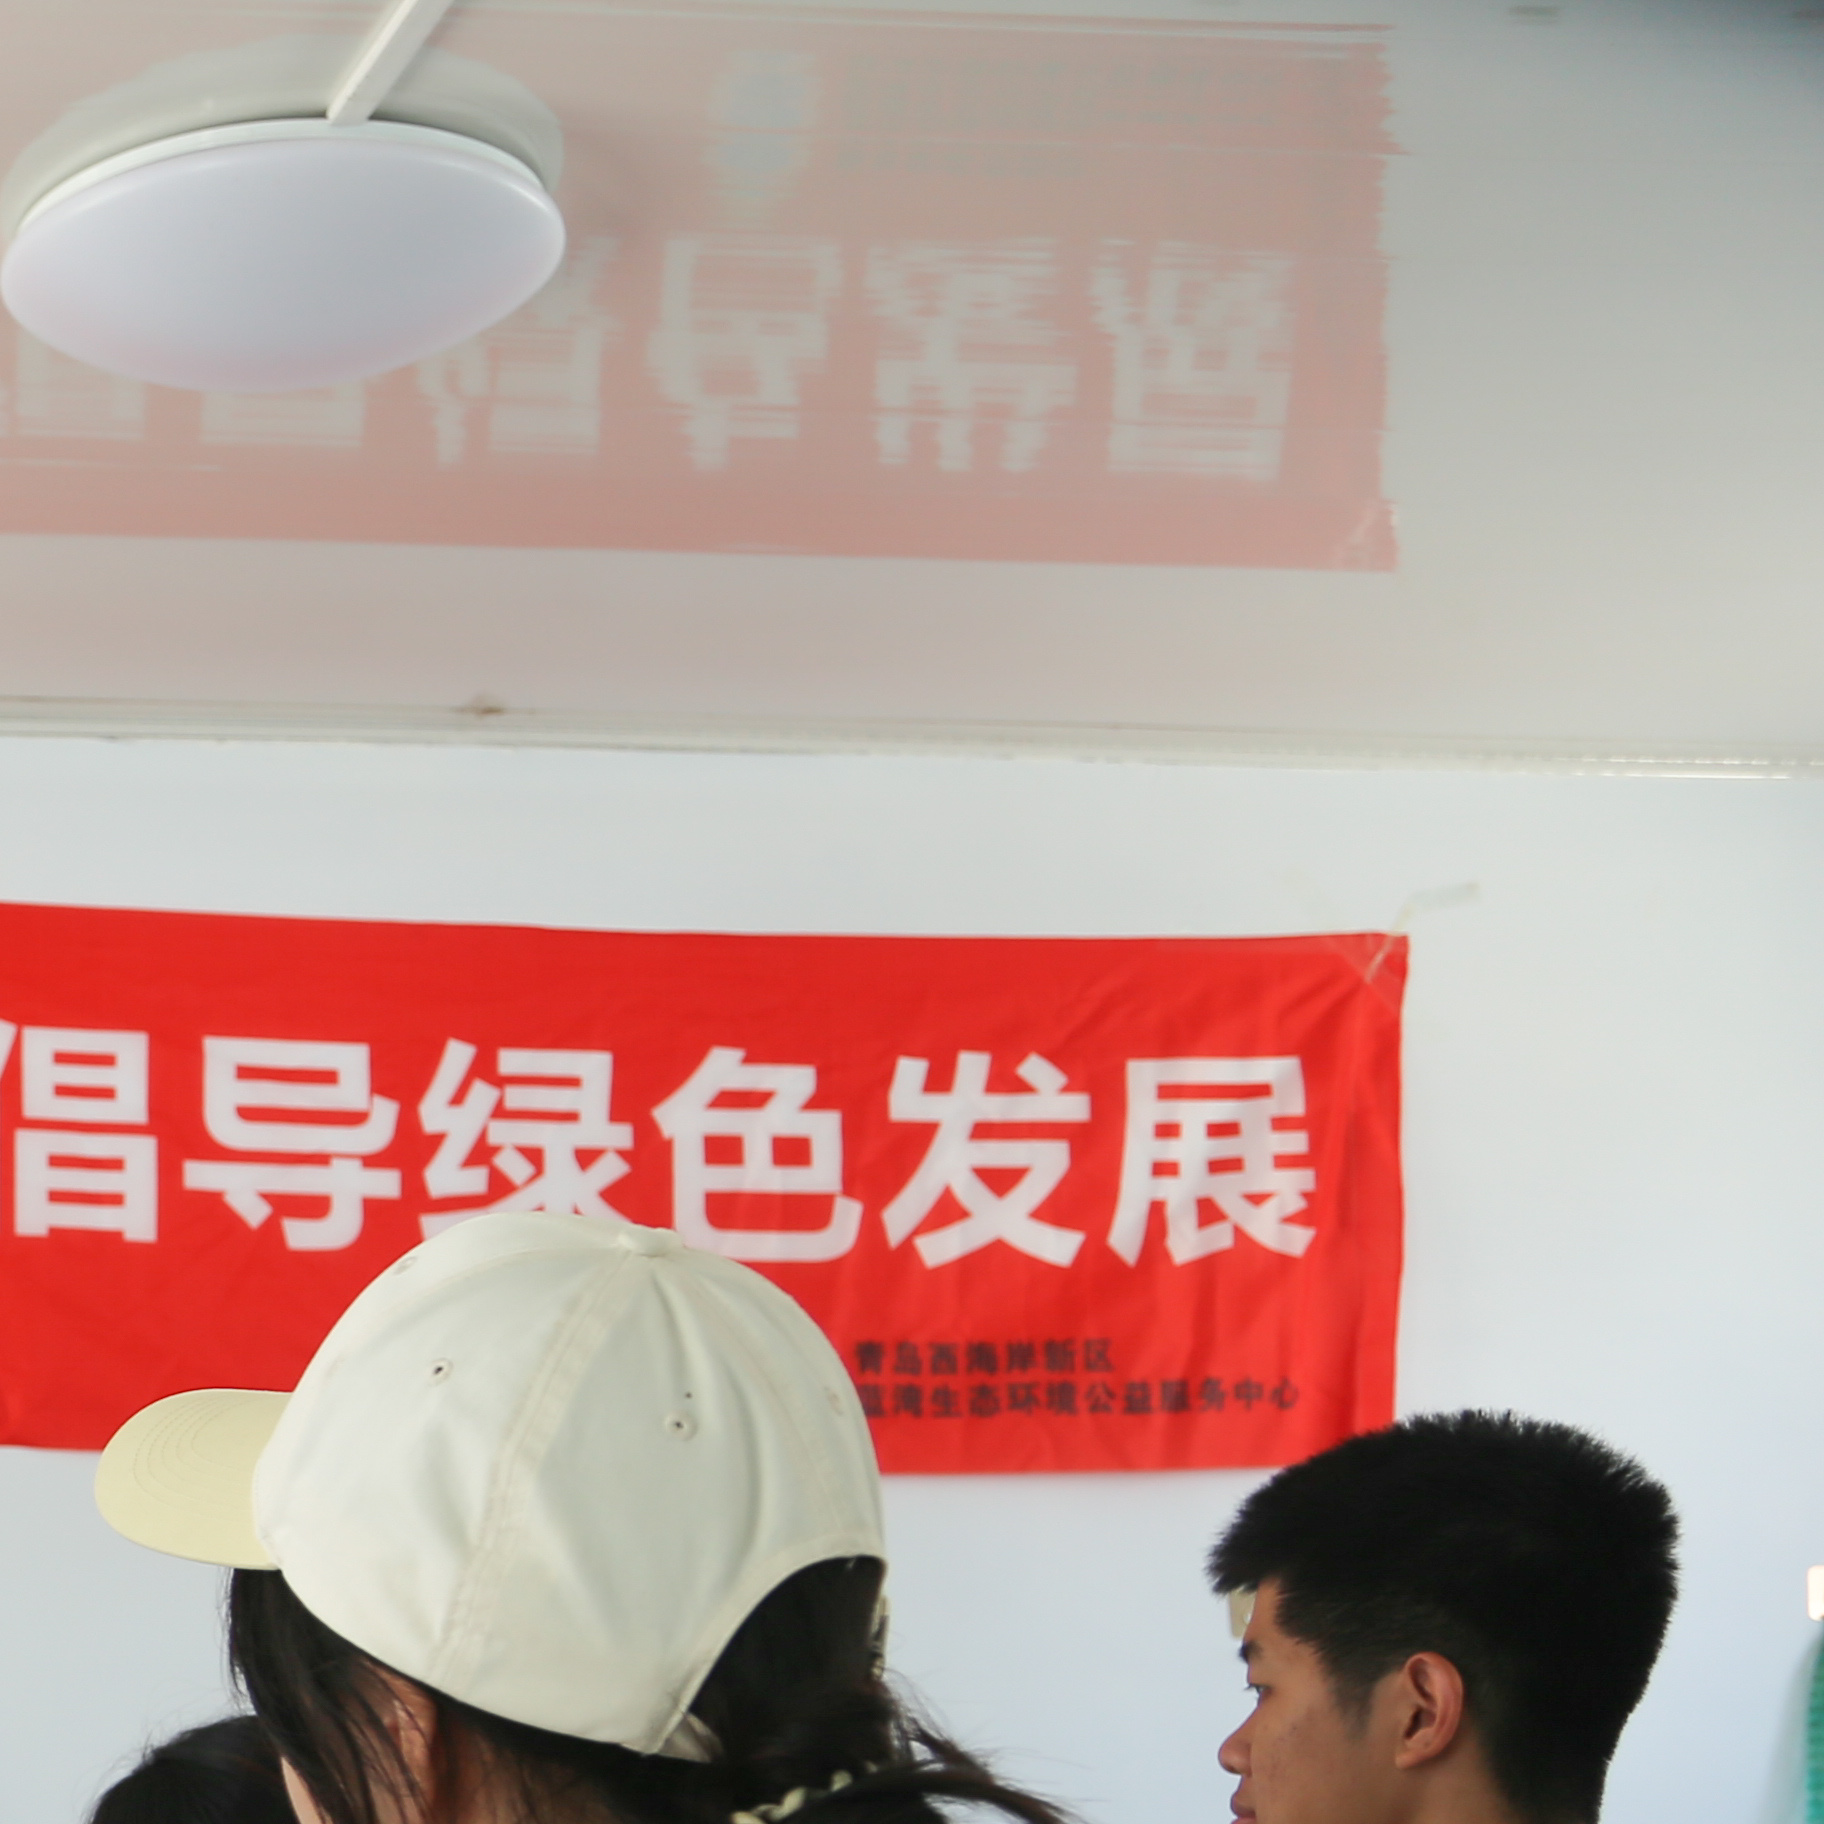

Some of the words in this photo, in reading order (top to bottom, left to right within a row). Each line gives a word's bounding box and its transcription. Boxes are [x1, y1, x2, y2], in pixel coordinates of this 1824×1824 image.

[856, 1338, 1114, 1375] 青岛西海岸新区
